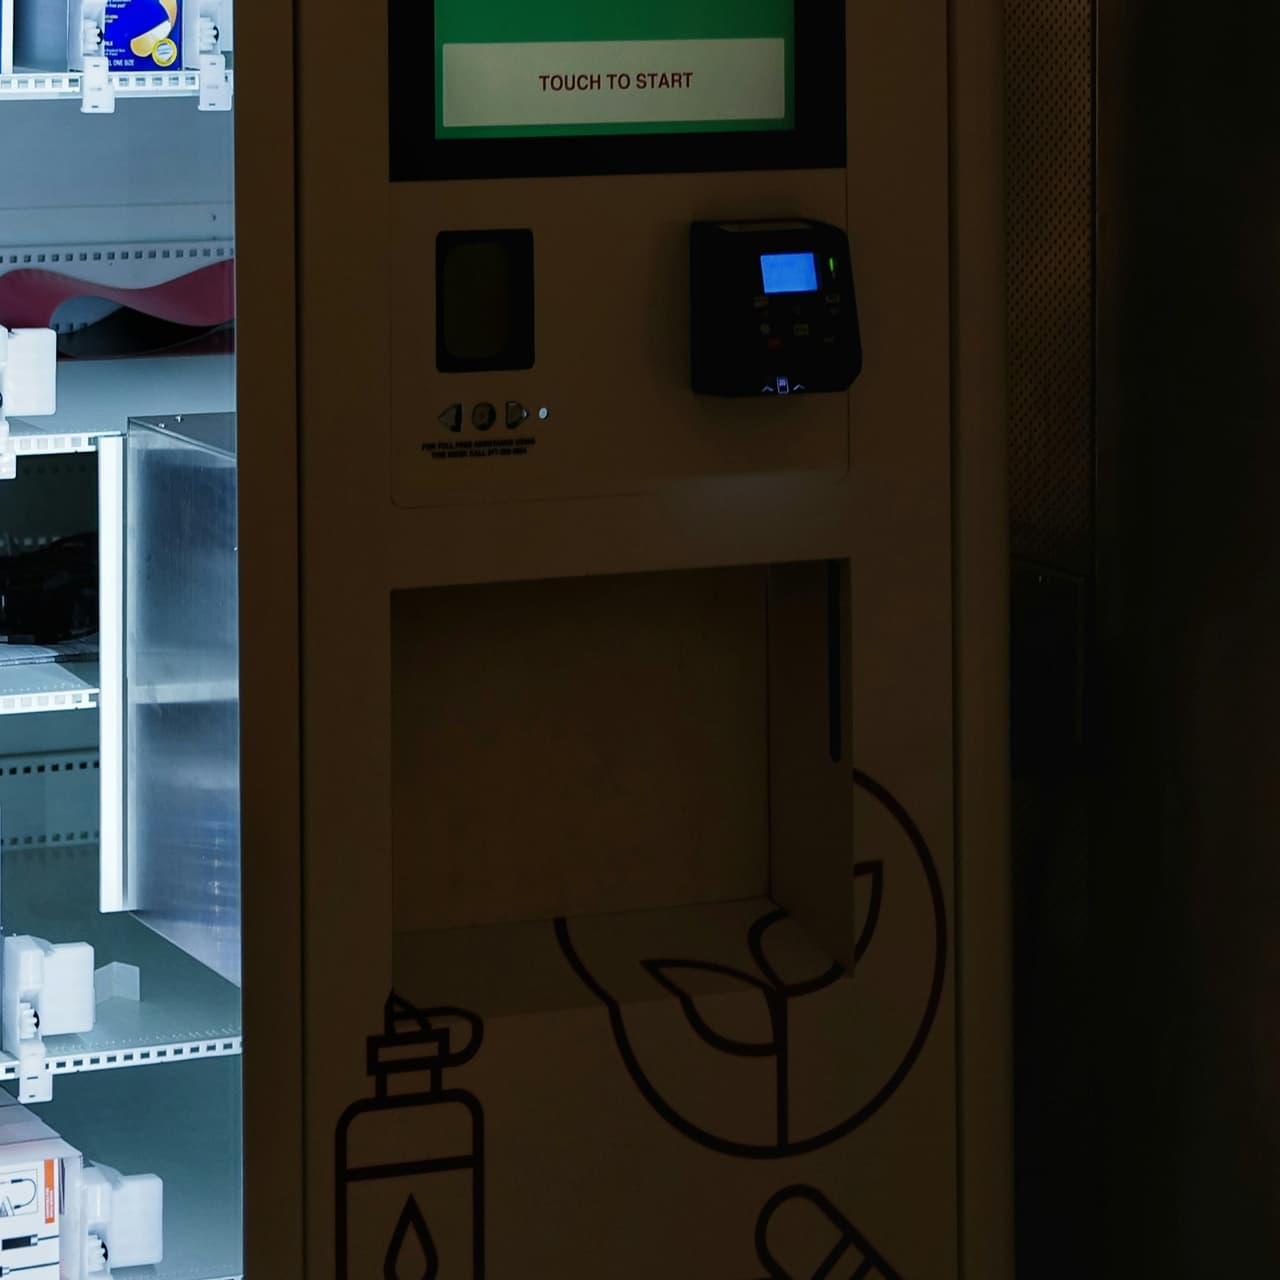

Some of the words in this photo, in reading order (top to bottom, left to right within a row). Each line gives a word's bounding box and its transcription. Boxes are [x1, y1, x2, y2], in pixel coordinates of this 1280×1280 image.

[539, 75, 601, 92] TOUCH
[606, 73, 631, 90] TO
[636, 72, 693, 89] START
